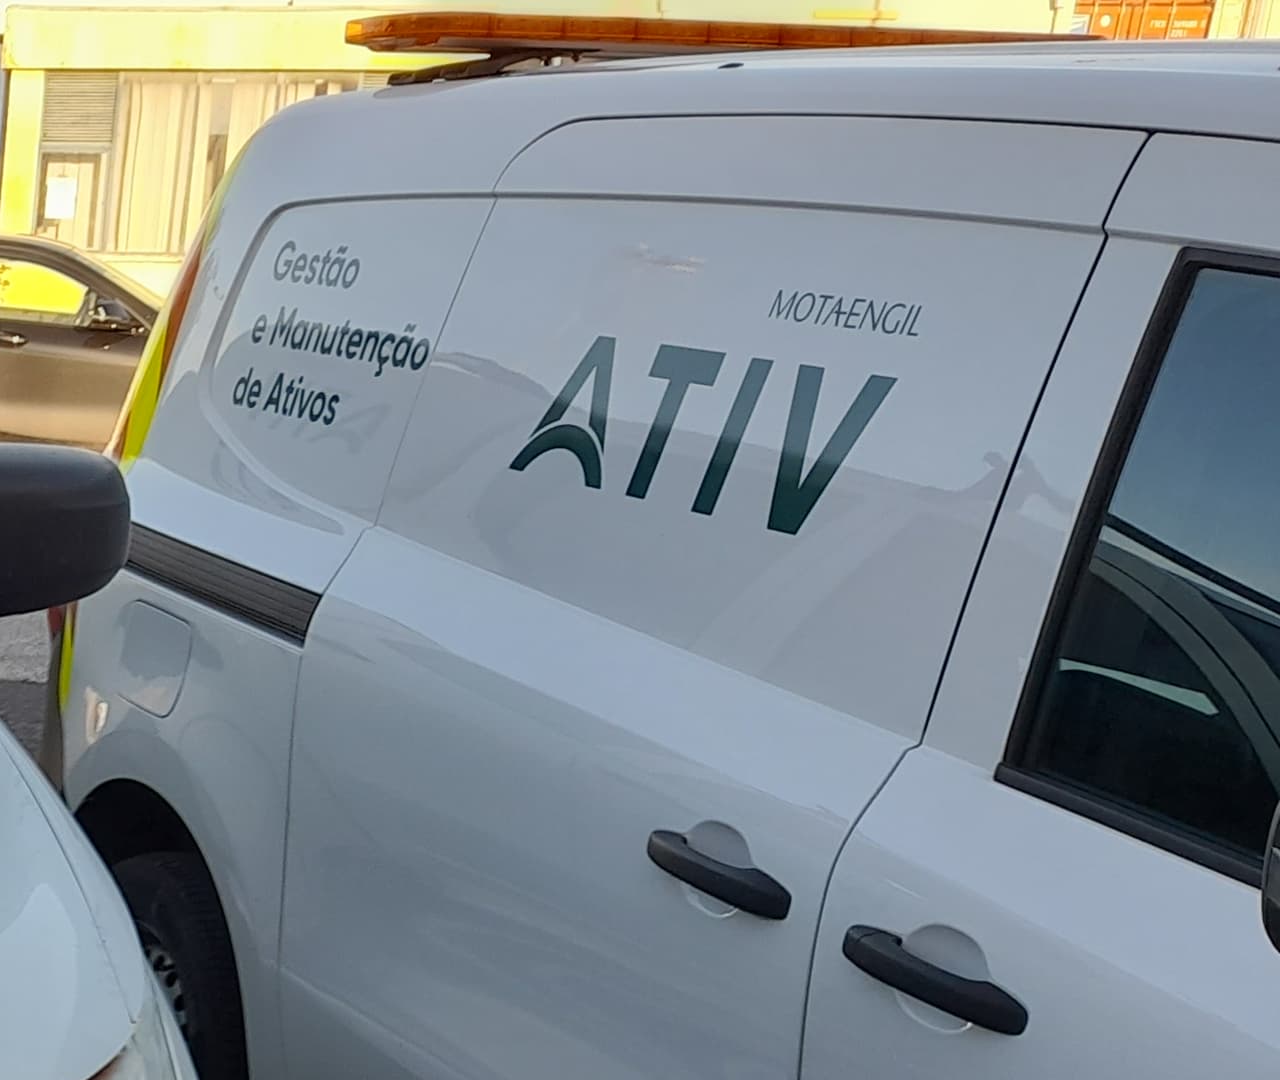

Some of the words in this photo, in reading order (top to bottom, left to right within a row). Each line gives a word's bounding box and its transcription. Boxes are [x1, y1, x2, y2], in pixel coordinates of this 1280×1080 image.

[273, 240, 360, 289] Gestão
[251, 314, 268, 344] e
[269, 305, 431, 378] Manutenção
[232, 367, 263, 409] de
[262, 372, 340, 426] Ativos
[509, 335, 898, 535] ATIV
